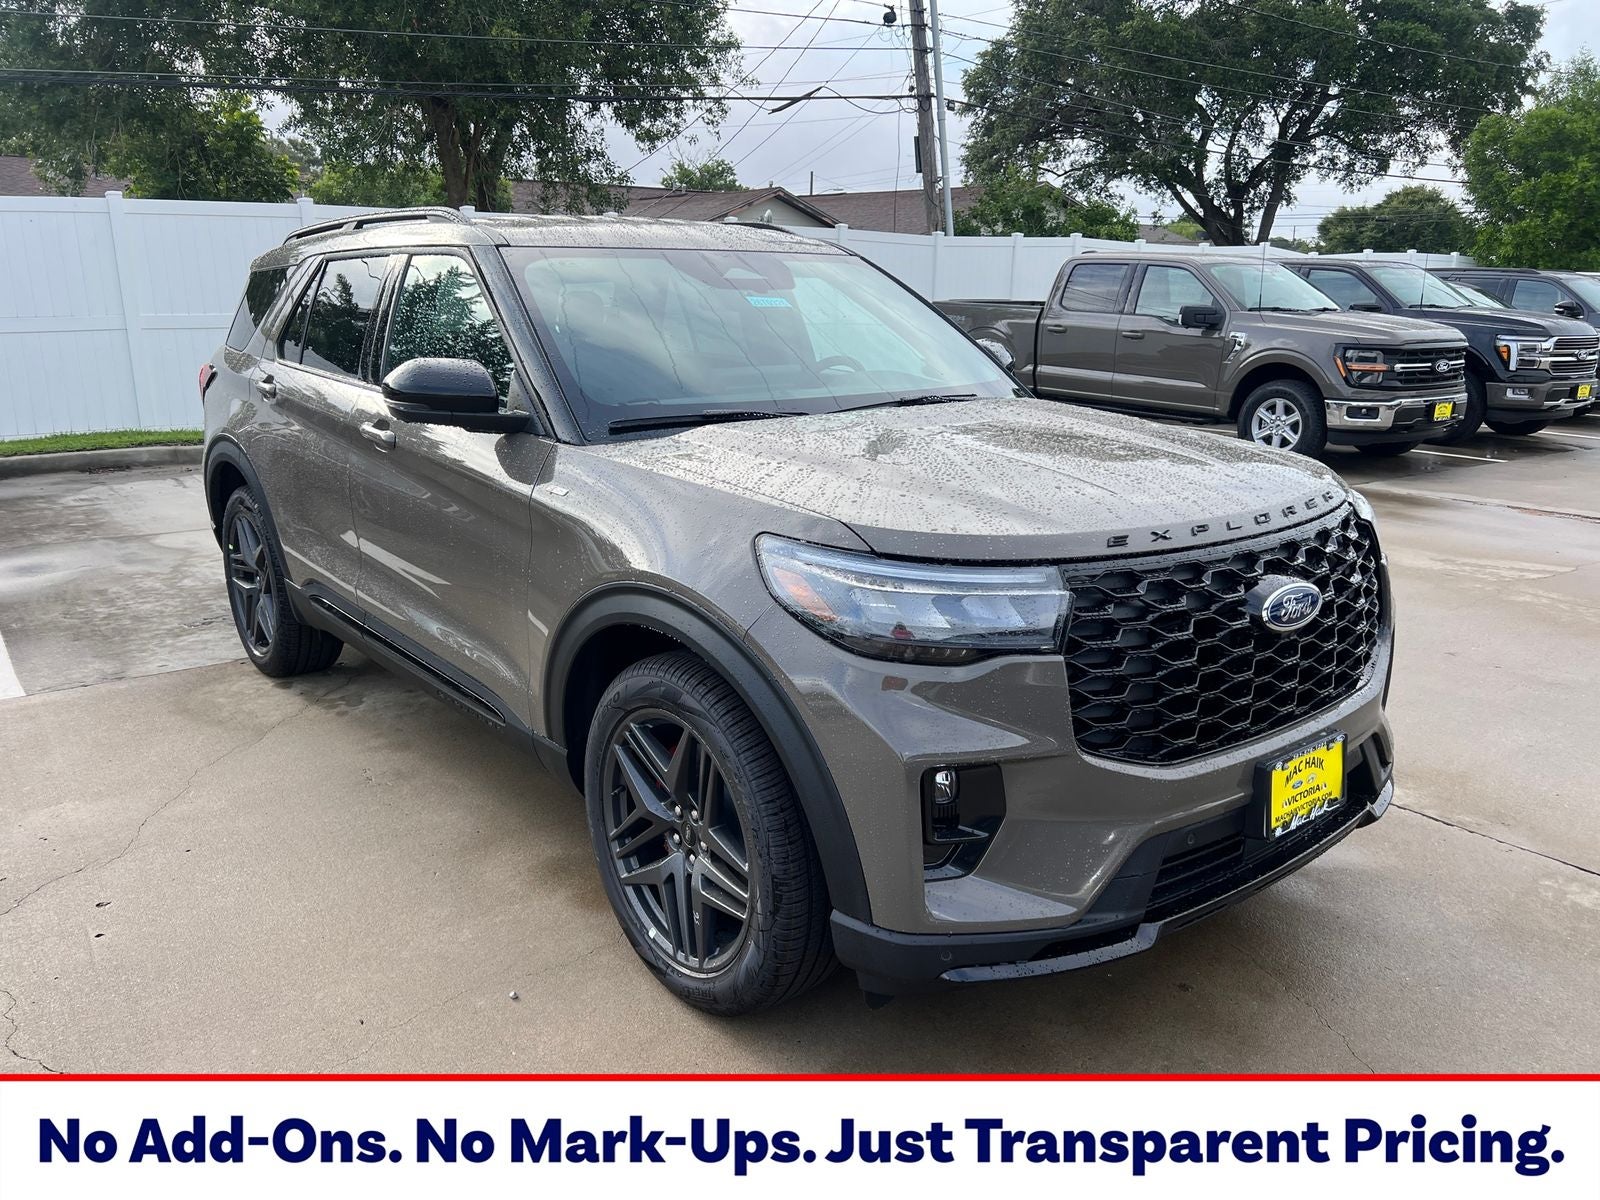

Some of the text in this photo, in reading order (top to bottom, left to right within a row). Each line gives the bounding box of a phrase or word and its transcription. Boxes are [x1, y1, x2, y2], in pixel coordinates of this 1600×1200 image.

[1106, 490, 1336, 548] EXPLORER
[1280, 592, 1313, 623] Ford
[1284, 759, 1304, 788] MAC
[1304, 755, 1325, 771] HAIK
[1287, 784, 1321, 806] VICTORIA
